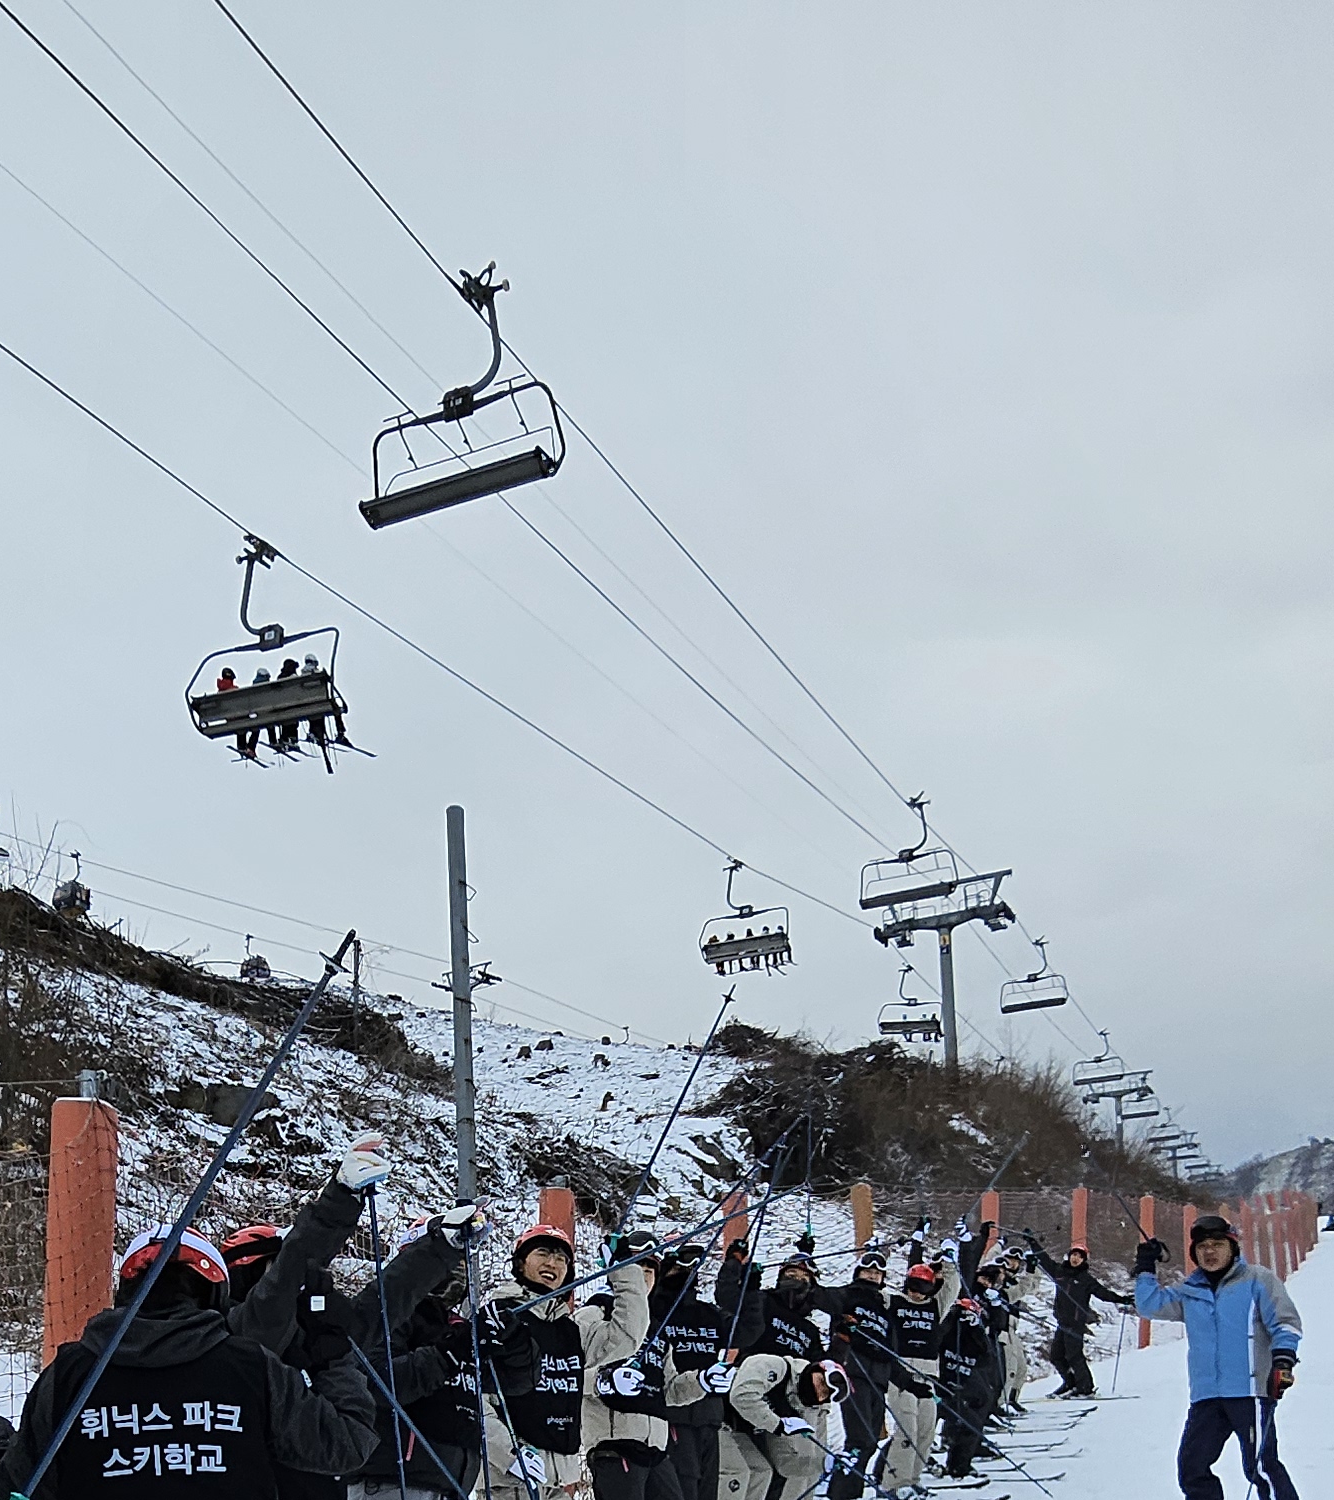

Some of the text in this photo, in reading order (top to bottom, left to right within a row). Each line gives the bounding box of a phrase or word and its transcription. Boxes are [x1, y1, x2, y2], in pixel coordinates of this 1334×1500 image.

[80, 1400, 243, 1440] 휘닉스 파크
[102, 1443, 227, 1477] 스키학교
